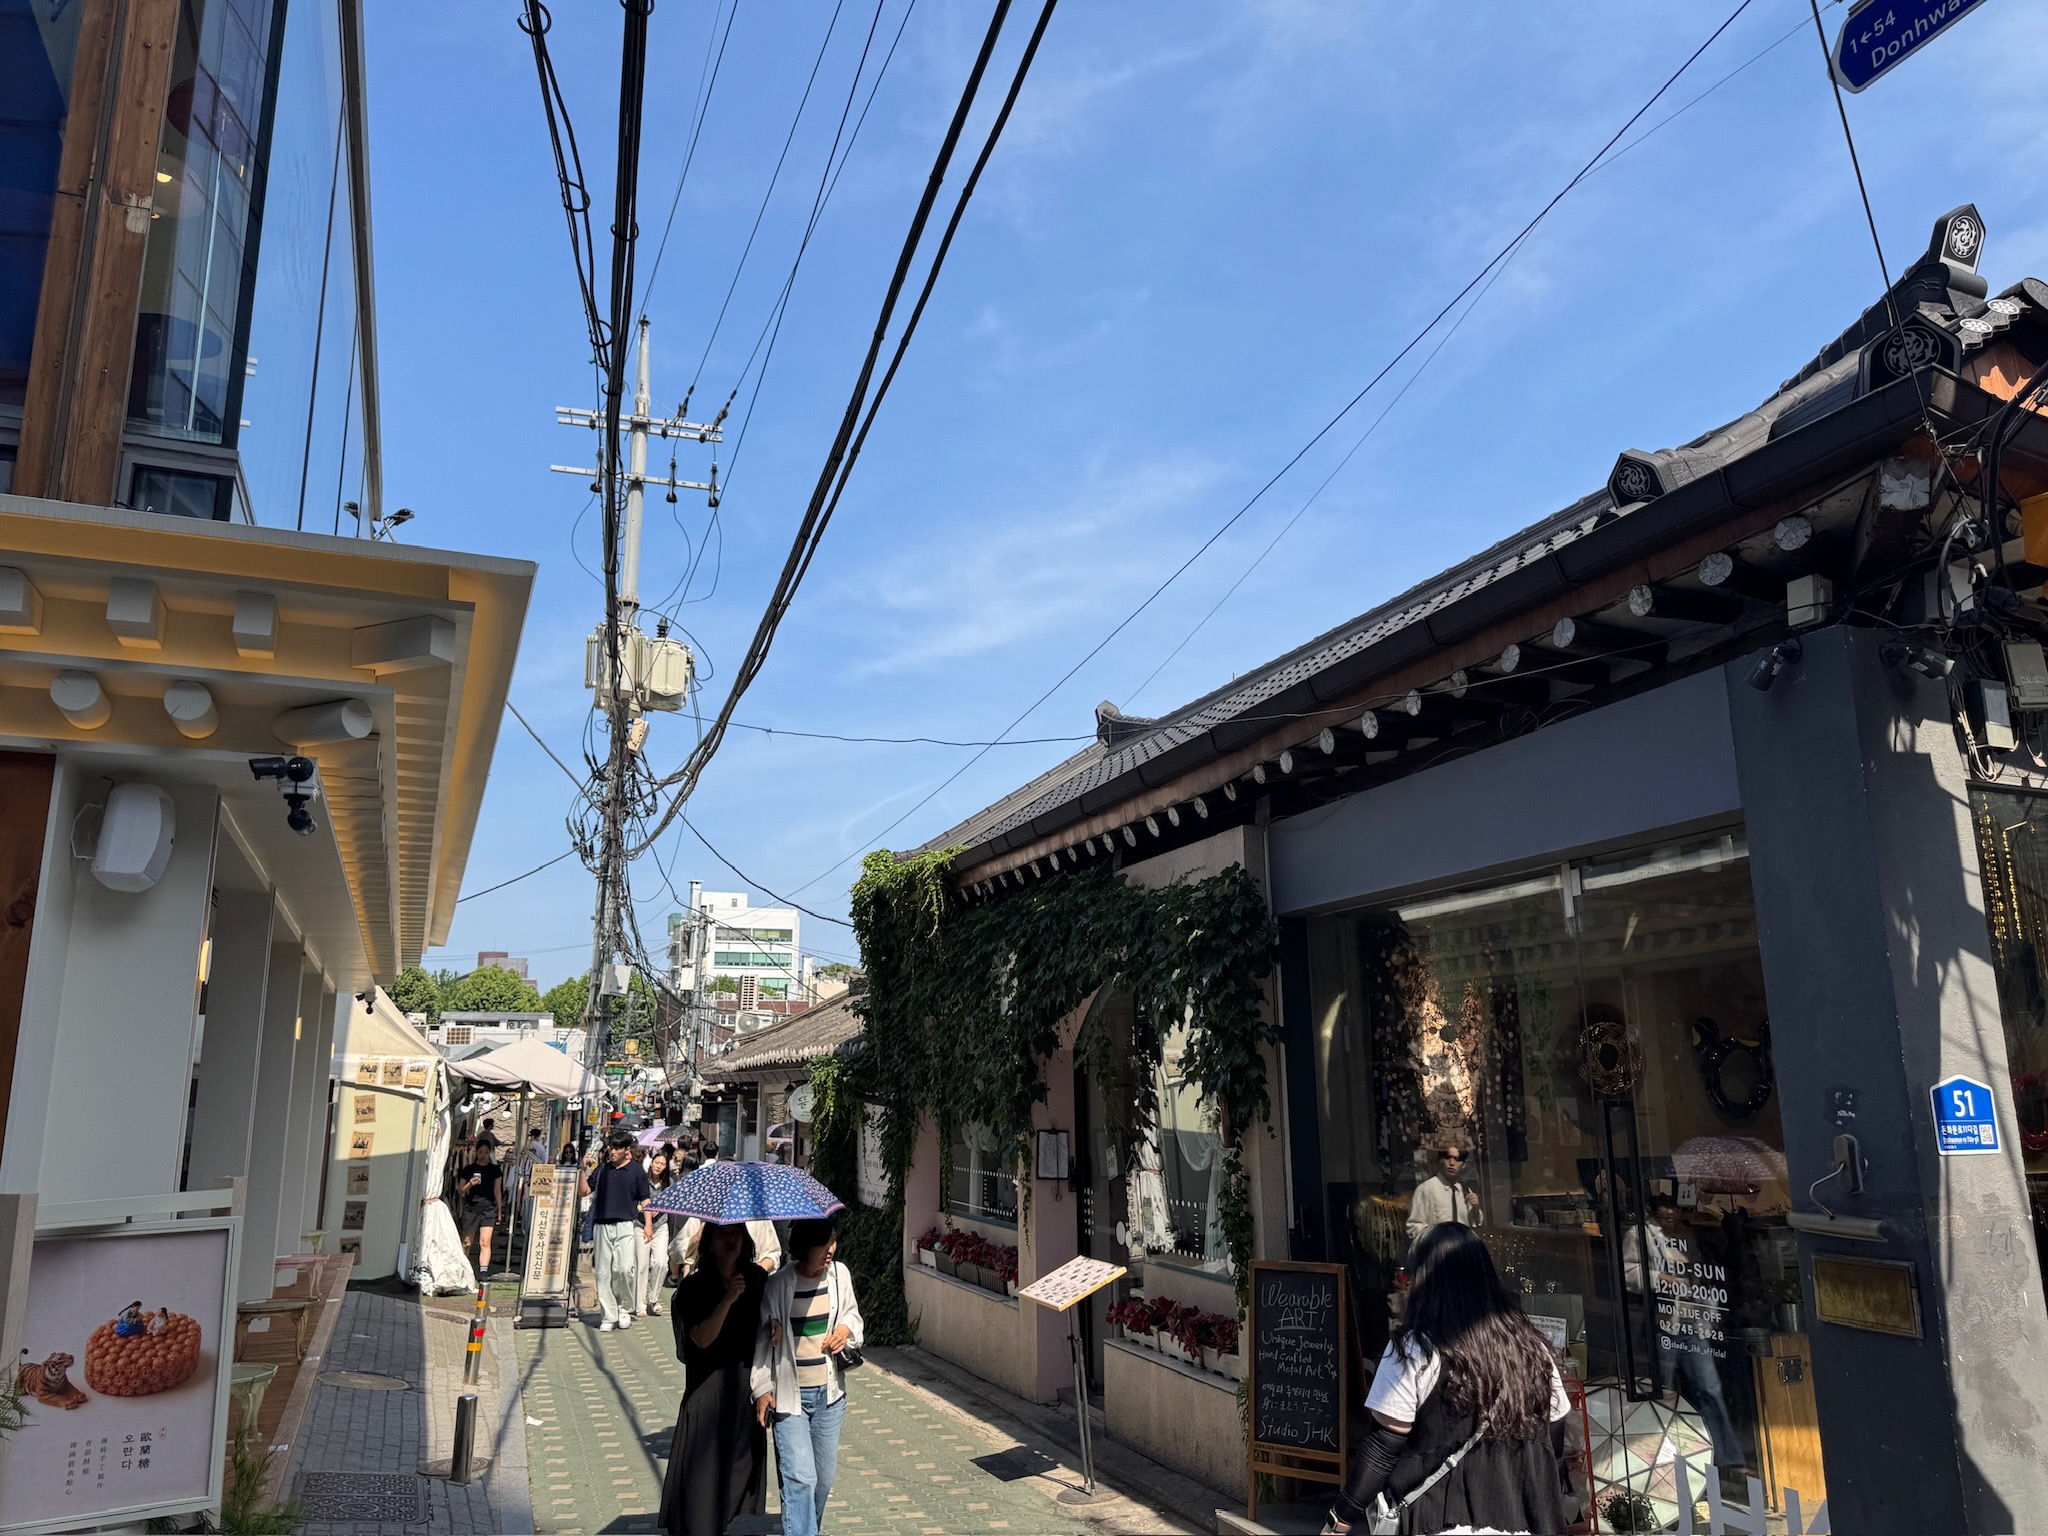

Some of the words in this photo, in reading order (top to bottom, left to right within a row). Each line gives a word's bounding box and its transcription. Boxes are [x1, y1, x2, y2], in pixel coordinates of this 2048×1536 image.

[1871, 0, 1966, 68] Donhwa
[1953, 1089, 1975, 1118] 51
[533, 1210, 549, 1280] 익선동사진신문
[1653, 1236, 1688, 1252] OPEN
[1653, 1257, 1725, 1281] WED-SUN
[1261, 1281, 1332, 1310] Wearable
[1656, 1279, 1727, 1303] 12:00-20:00
[1658, 1303, 1700, 1320] MON-TUE
[1702, 1311, 1722, 1323] OFF
[1261, 1331, 1296, 1349] Unique
[1258, 1349, 1278, 1362] Hand
[1277, 1361, 1302, 1376] Metal
[1305, 1363, 1324, 1379] Art
[1258, 1415, 1299, 1439] Studio
[1298, 1421, 1337, 1448] JHK
[121, 1434, 135, 1470] 오란다
